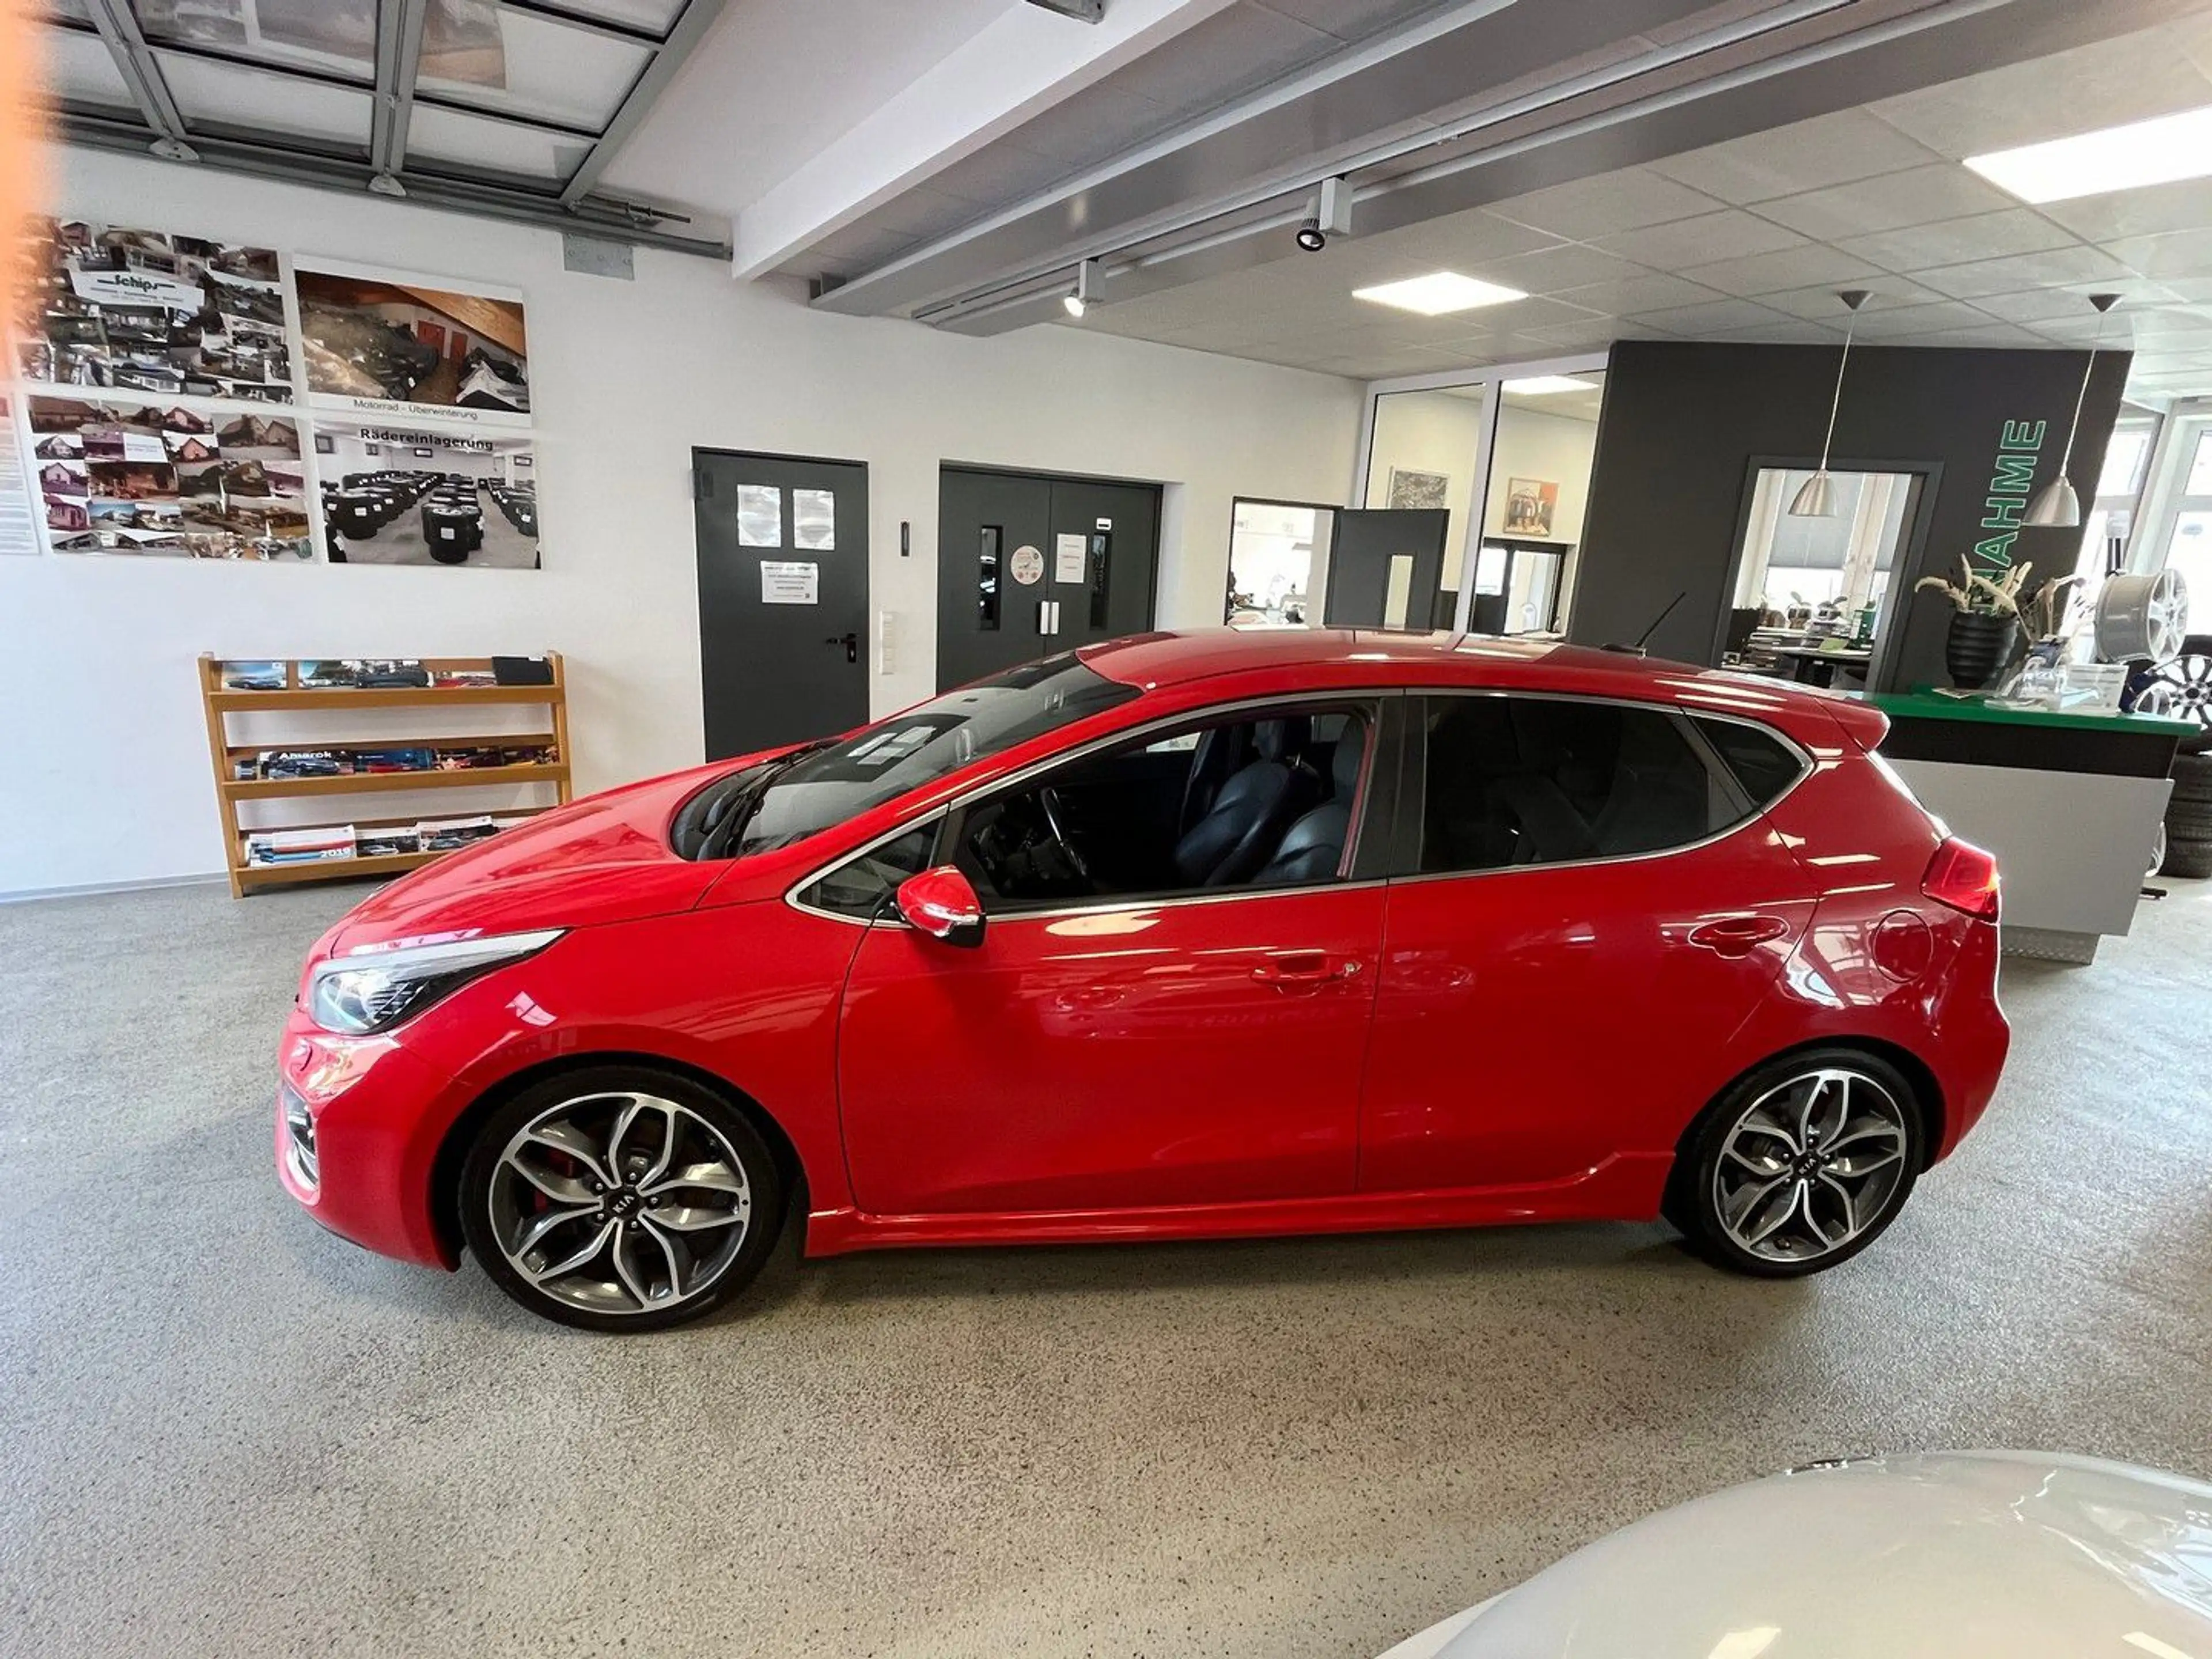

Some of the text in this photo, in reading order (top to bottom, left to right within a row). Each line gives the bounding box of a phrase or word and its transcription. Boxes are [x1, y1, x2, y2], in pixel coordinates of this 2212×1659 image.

[353, 399, 399, 412] Motorrad
[408, 404, 479, 421] Überwinterung
[360, 428, 493, 451] Rädereinlagerung
[279, 751, 332, 760] Amarok
[612, 1195, 635, 1214] KIA
